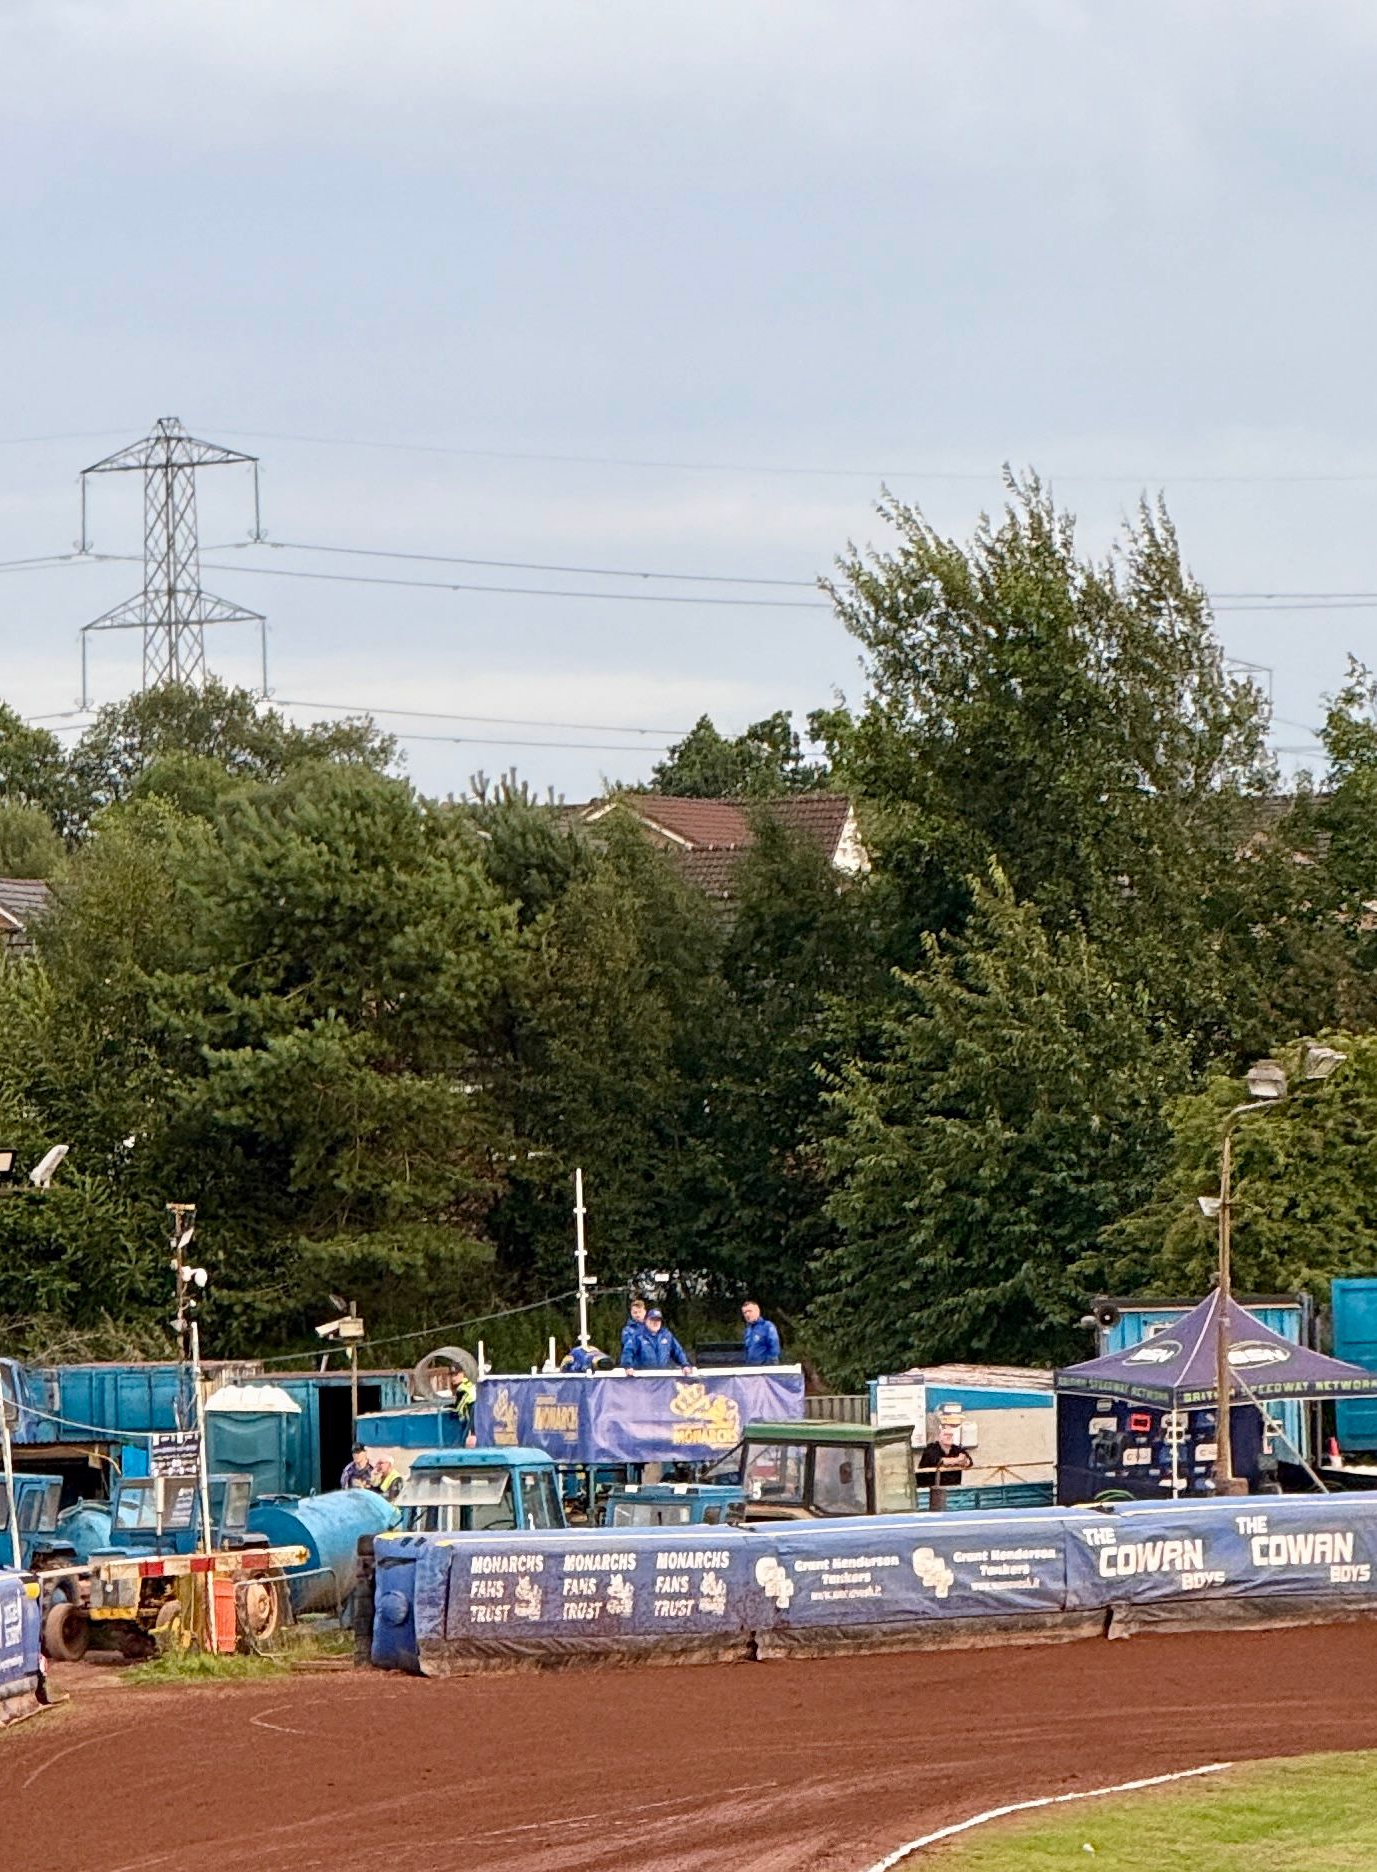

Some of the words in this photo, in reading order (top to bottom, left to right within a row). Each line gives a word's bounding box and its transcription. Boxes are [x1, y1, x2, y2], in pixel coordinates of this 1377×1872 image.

[1234, 1516, 1268, 1535] THE
[1082, 1527, 1116, 1546] THE
[1099, 1539, 1204, 1578] COWAN
[1251, 1532, 1354, 1567] COWAN
[470, 1555, 544, 1574] MONARCHS
[562, 1553, 637, 1572] MONARCHS
[656, 1551, 730, 1569] MONARCHS
[1181, 1571, 1226, 1591] BOYS
[1330, 1564, 1370, 1583] BOYS
[470, 1580, 504, 1598] FANS
[562, 1578, 597, 1596] FANS
[655, 1576, 690, 1592] FANS
[470, 1604, 511, 1623] TRUST
[562, 1602, 603, 1620] TRUST
[654, 1600, 695, 1616] TRUST
